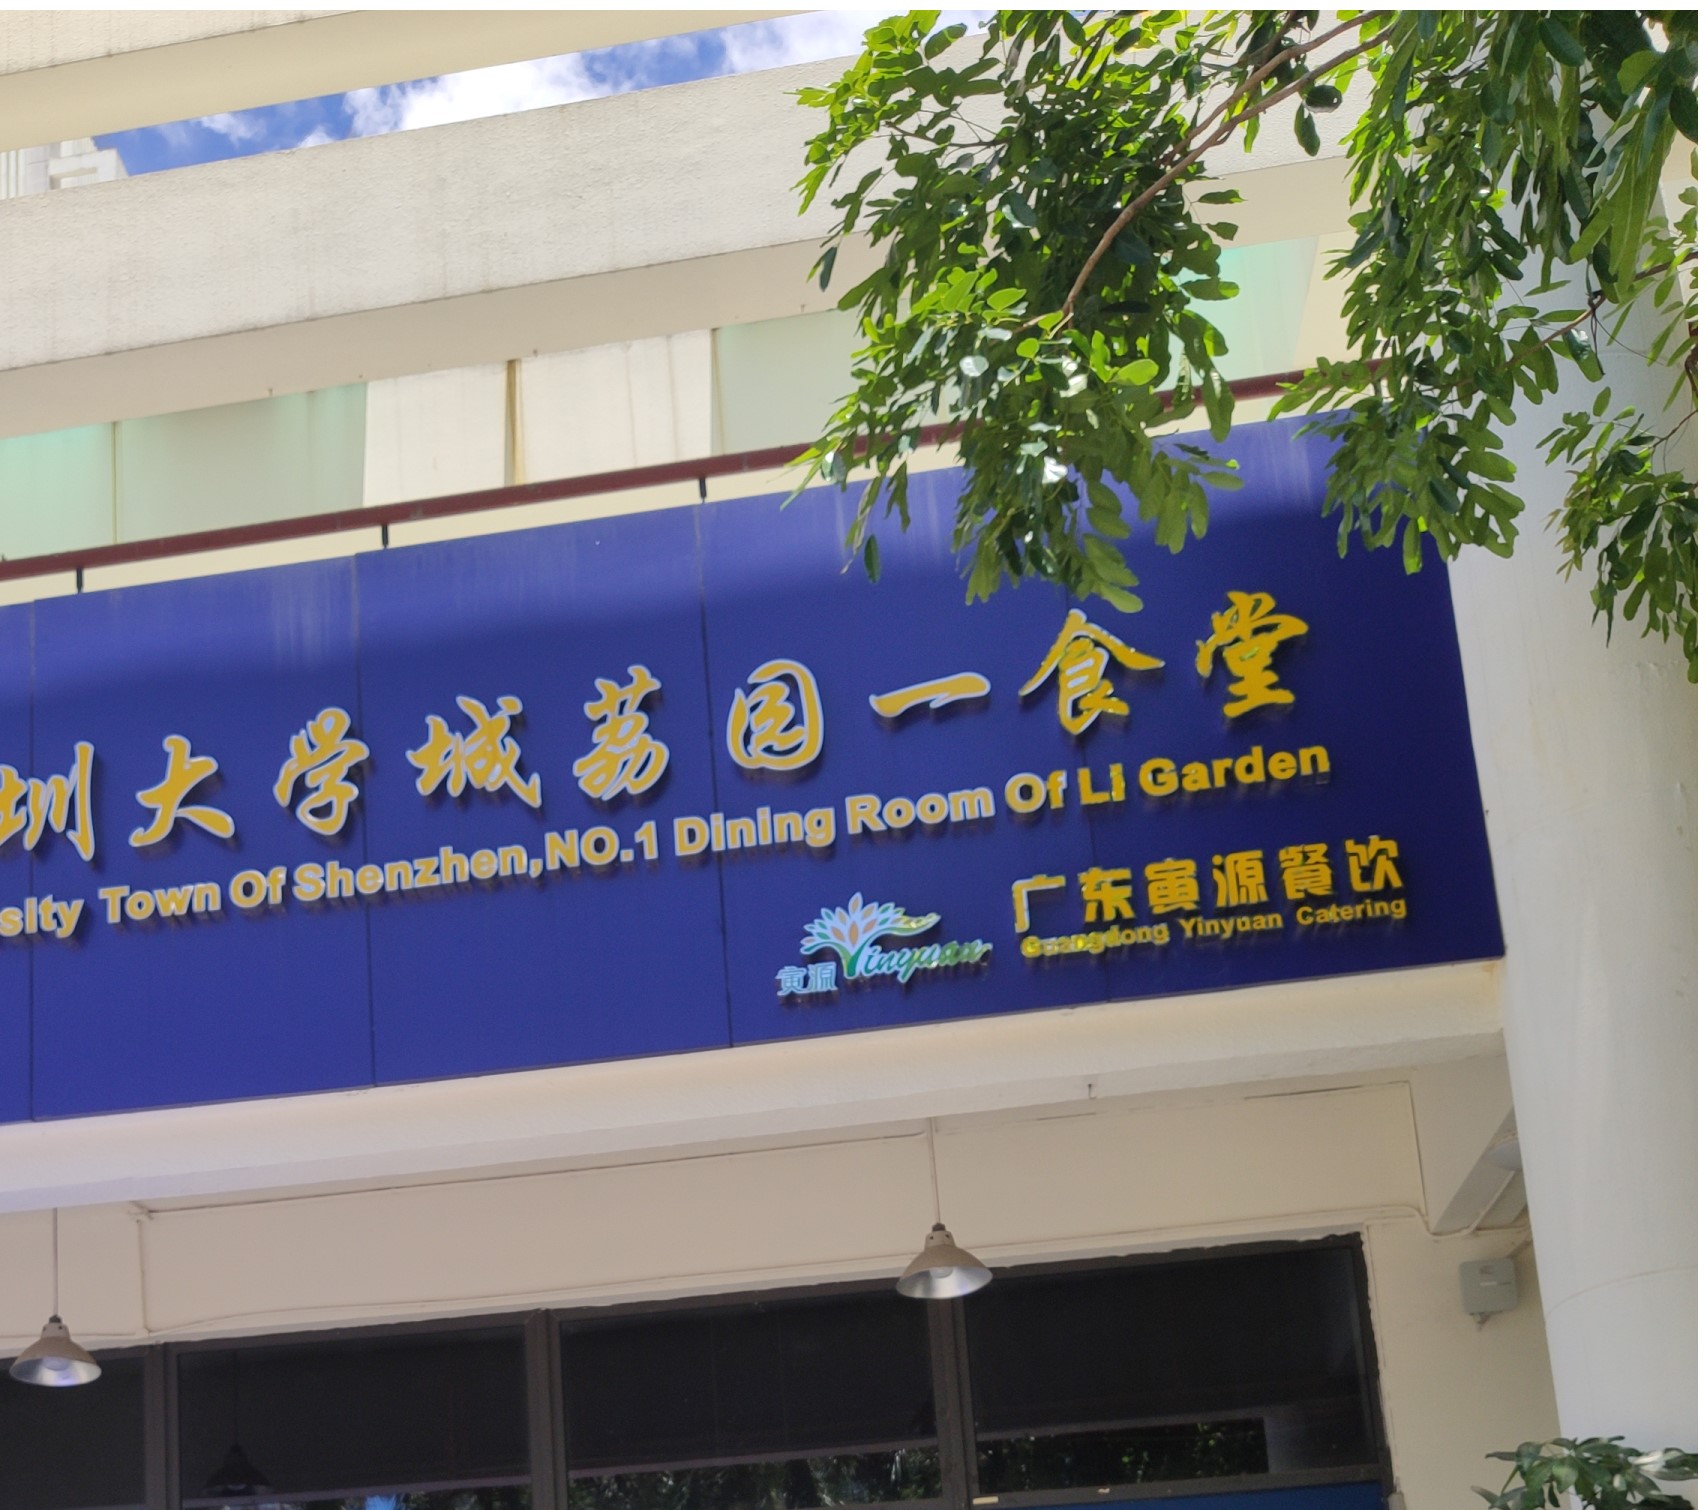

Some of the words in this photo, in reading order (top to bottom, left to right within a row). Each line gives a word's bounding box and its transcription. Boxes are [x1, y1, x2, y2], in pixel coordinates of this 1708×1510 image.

[100, 883, 221, 927] Town
[231, 868, 284, 909] Of
[674, 804, 835, 858] Dining
[846, 788, 994, 834] Room
[1006, 771, 1066, 814] Of
[1078, 762, 1125, 806] Li
[1138, 742, 1330, 800] Garden
[1010, 837, 1402, 934] 广东寅源餐饮
[1021, 925, 1169, 959] Guangdong
[1179, 911, 1283, 939] Yinyuan
[1297, 898, 1407, 927] Catering
[776, 965, 837, 995] 寅源
